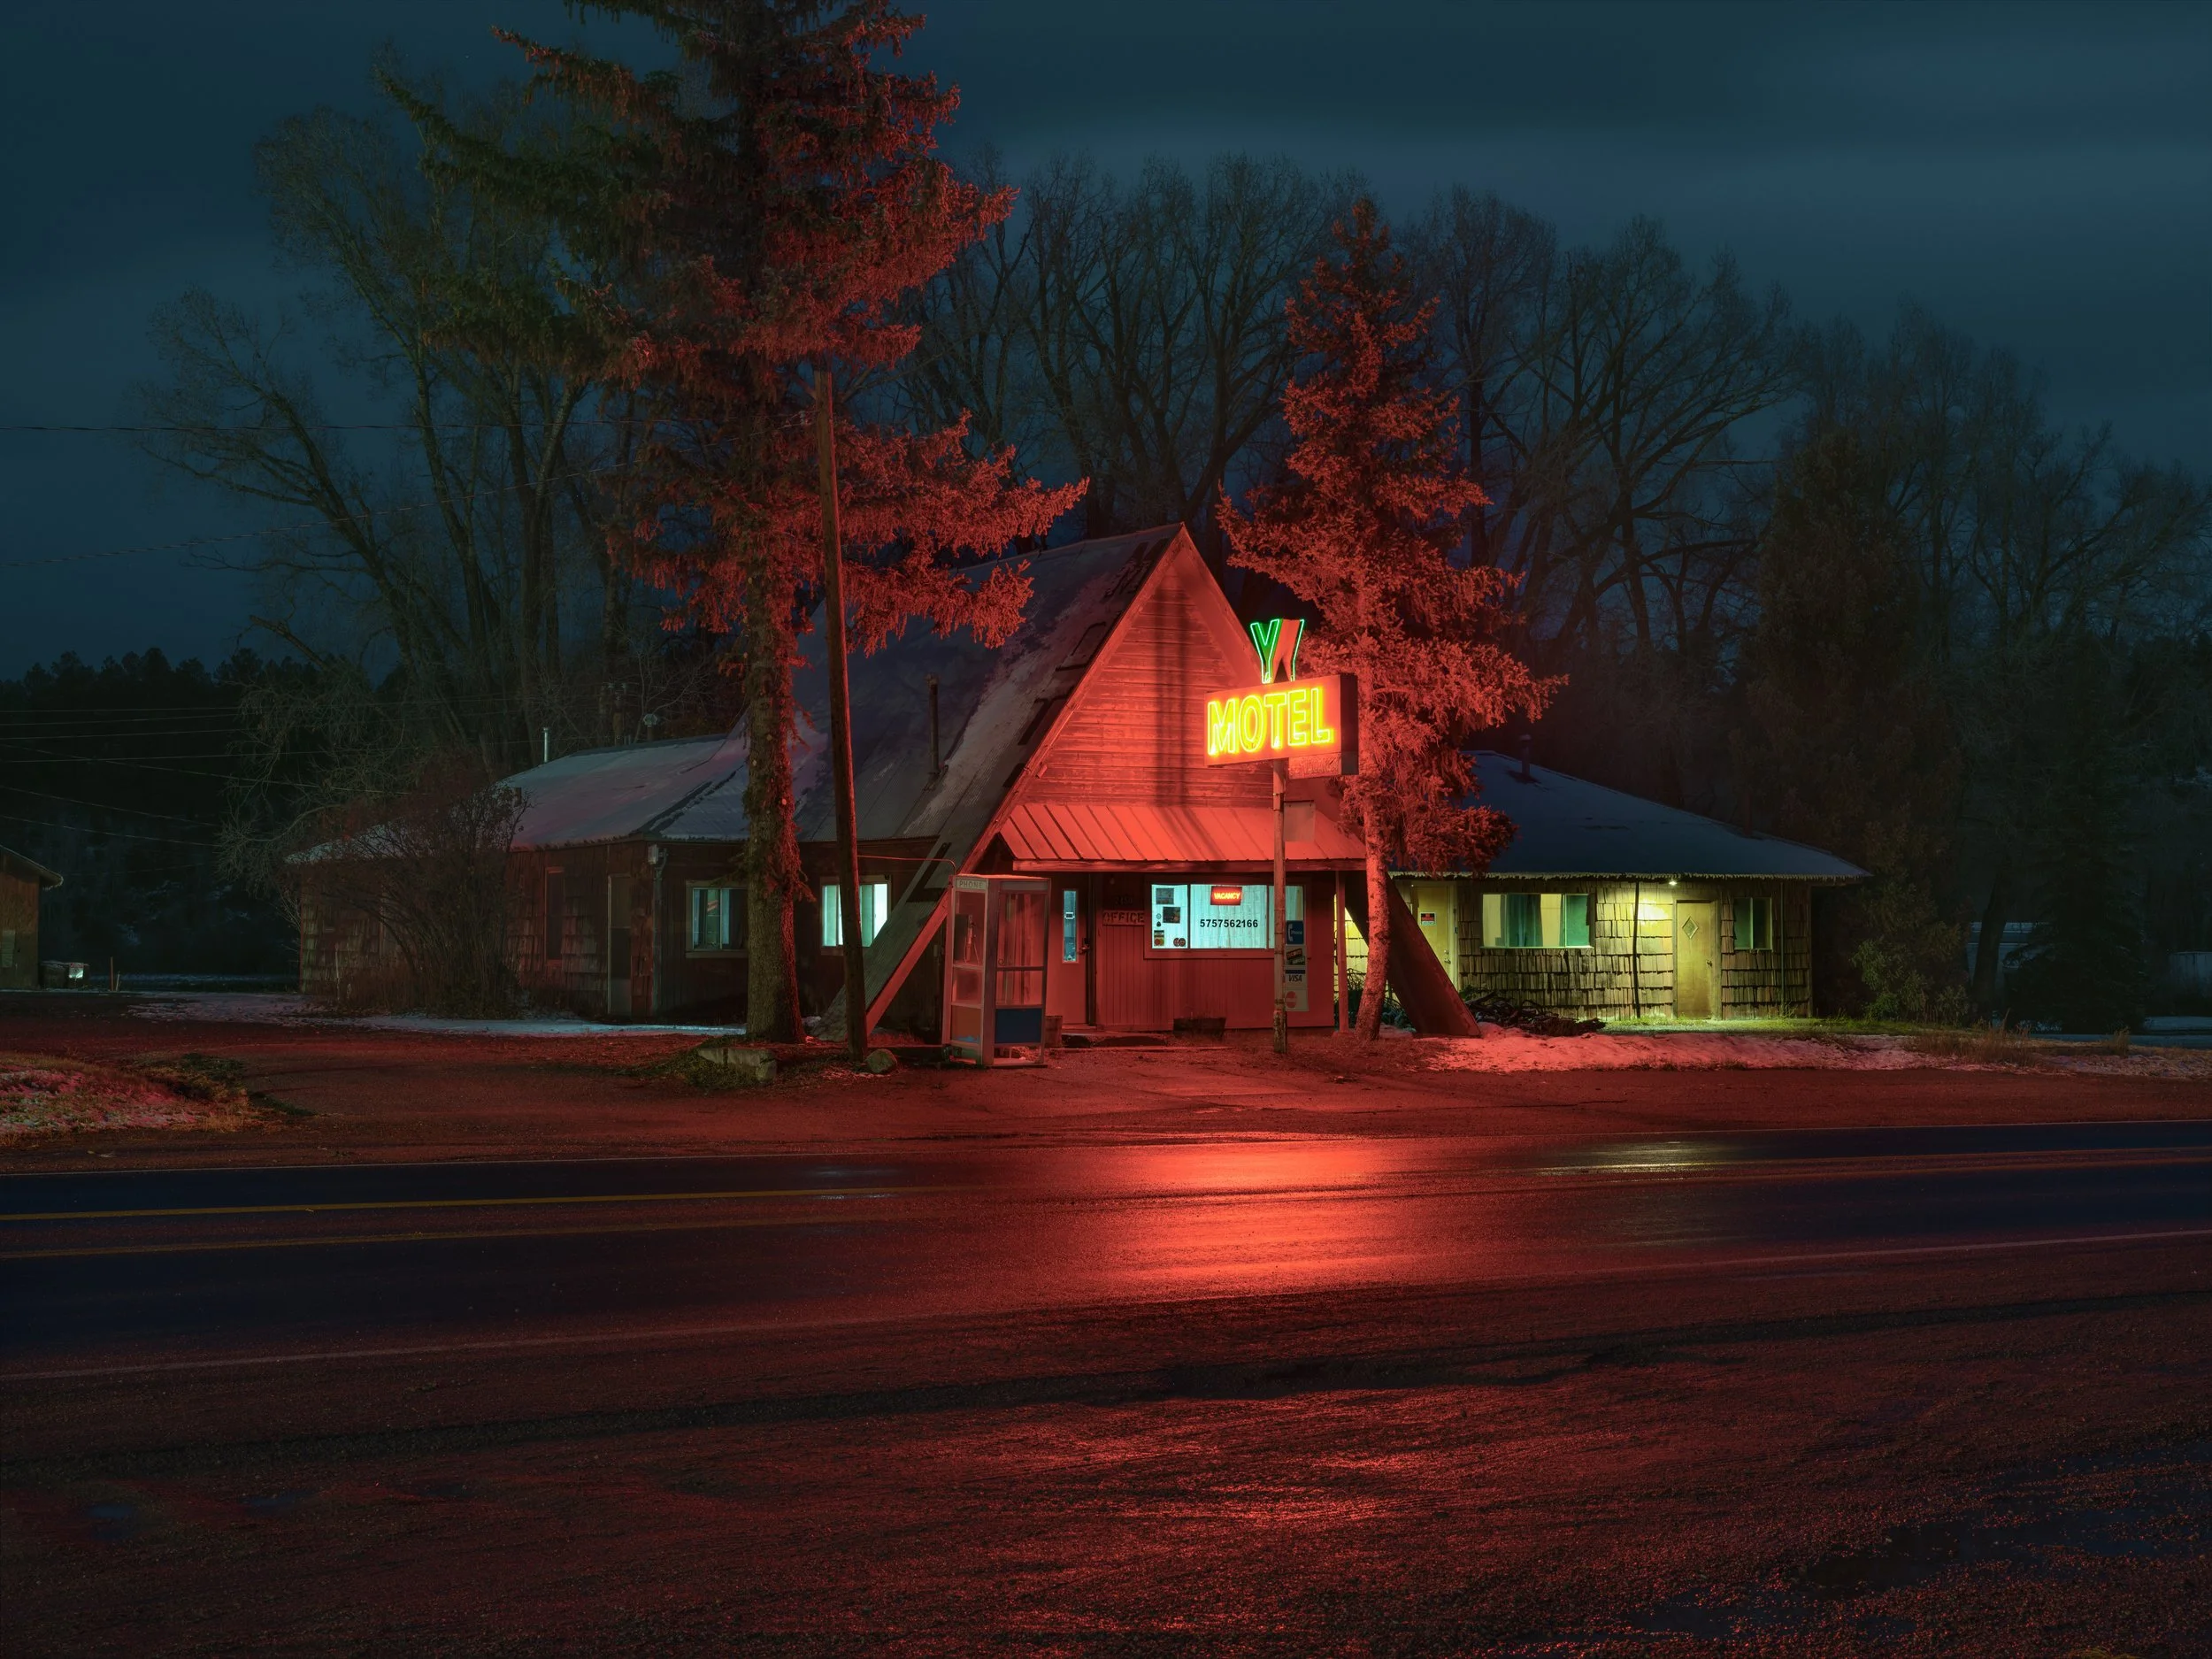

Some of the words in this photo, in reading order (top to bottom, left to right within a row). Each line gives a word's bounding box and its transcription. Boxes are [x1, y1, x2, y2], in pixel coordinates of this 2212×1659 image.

[1208, 688, 1334, 756] MOTEL
[1102, 911, 1145, 923] OFFICE
[1200, 919, 1258, 928] 5757562166
